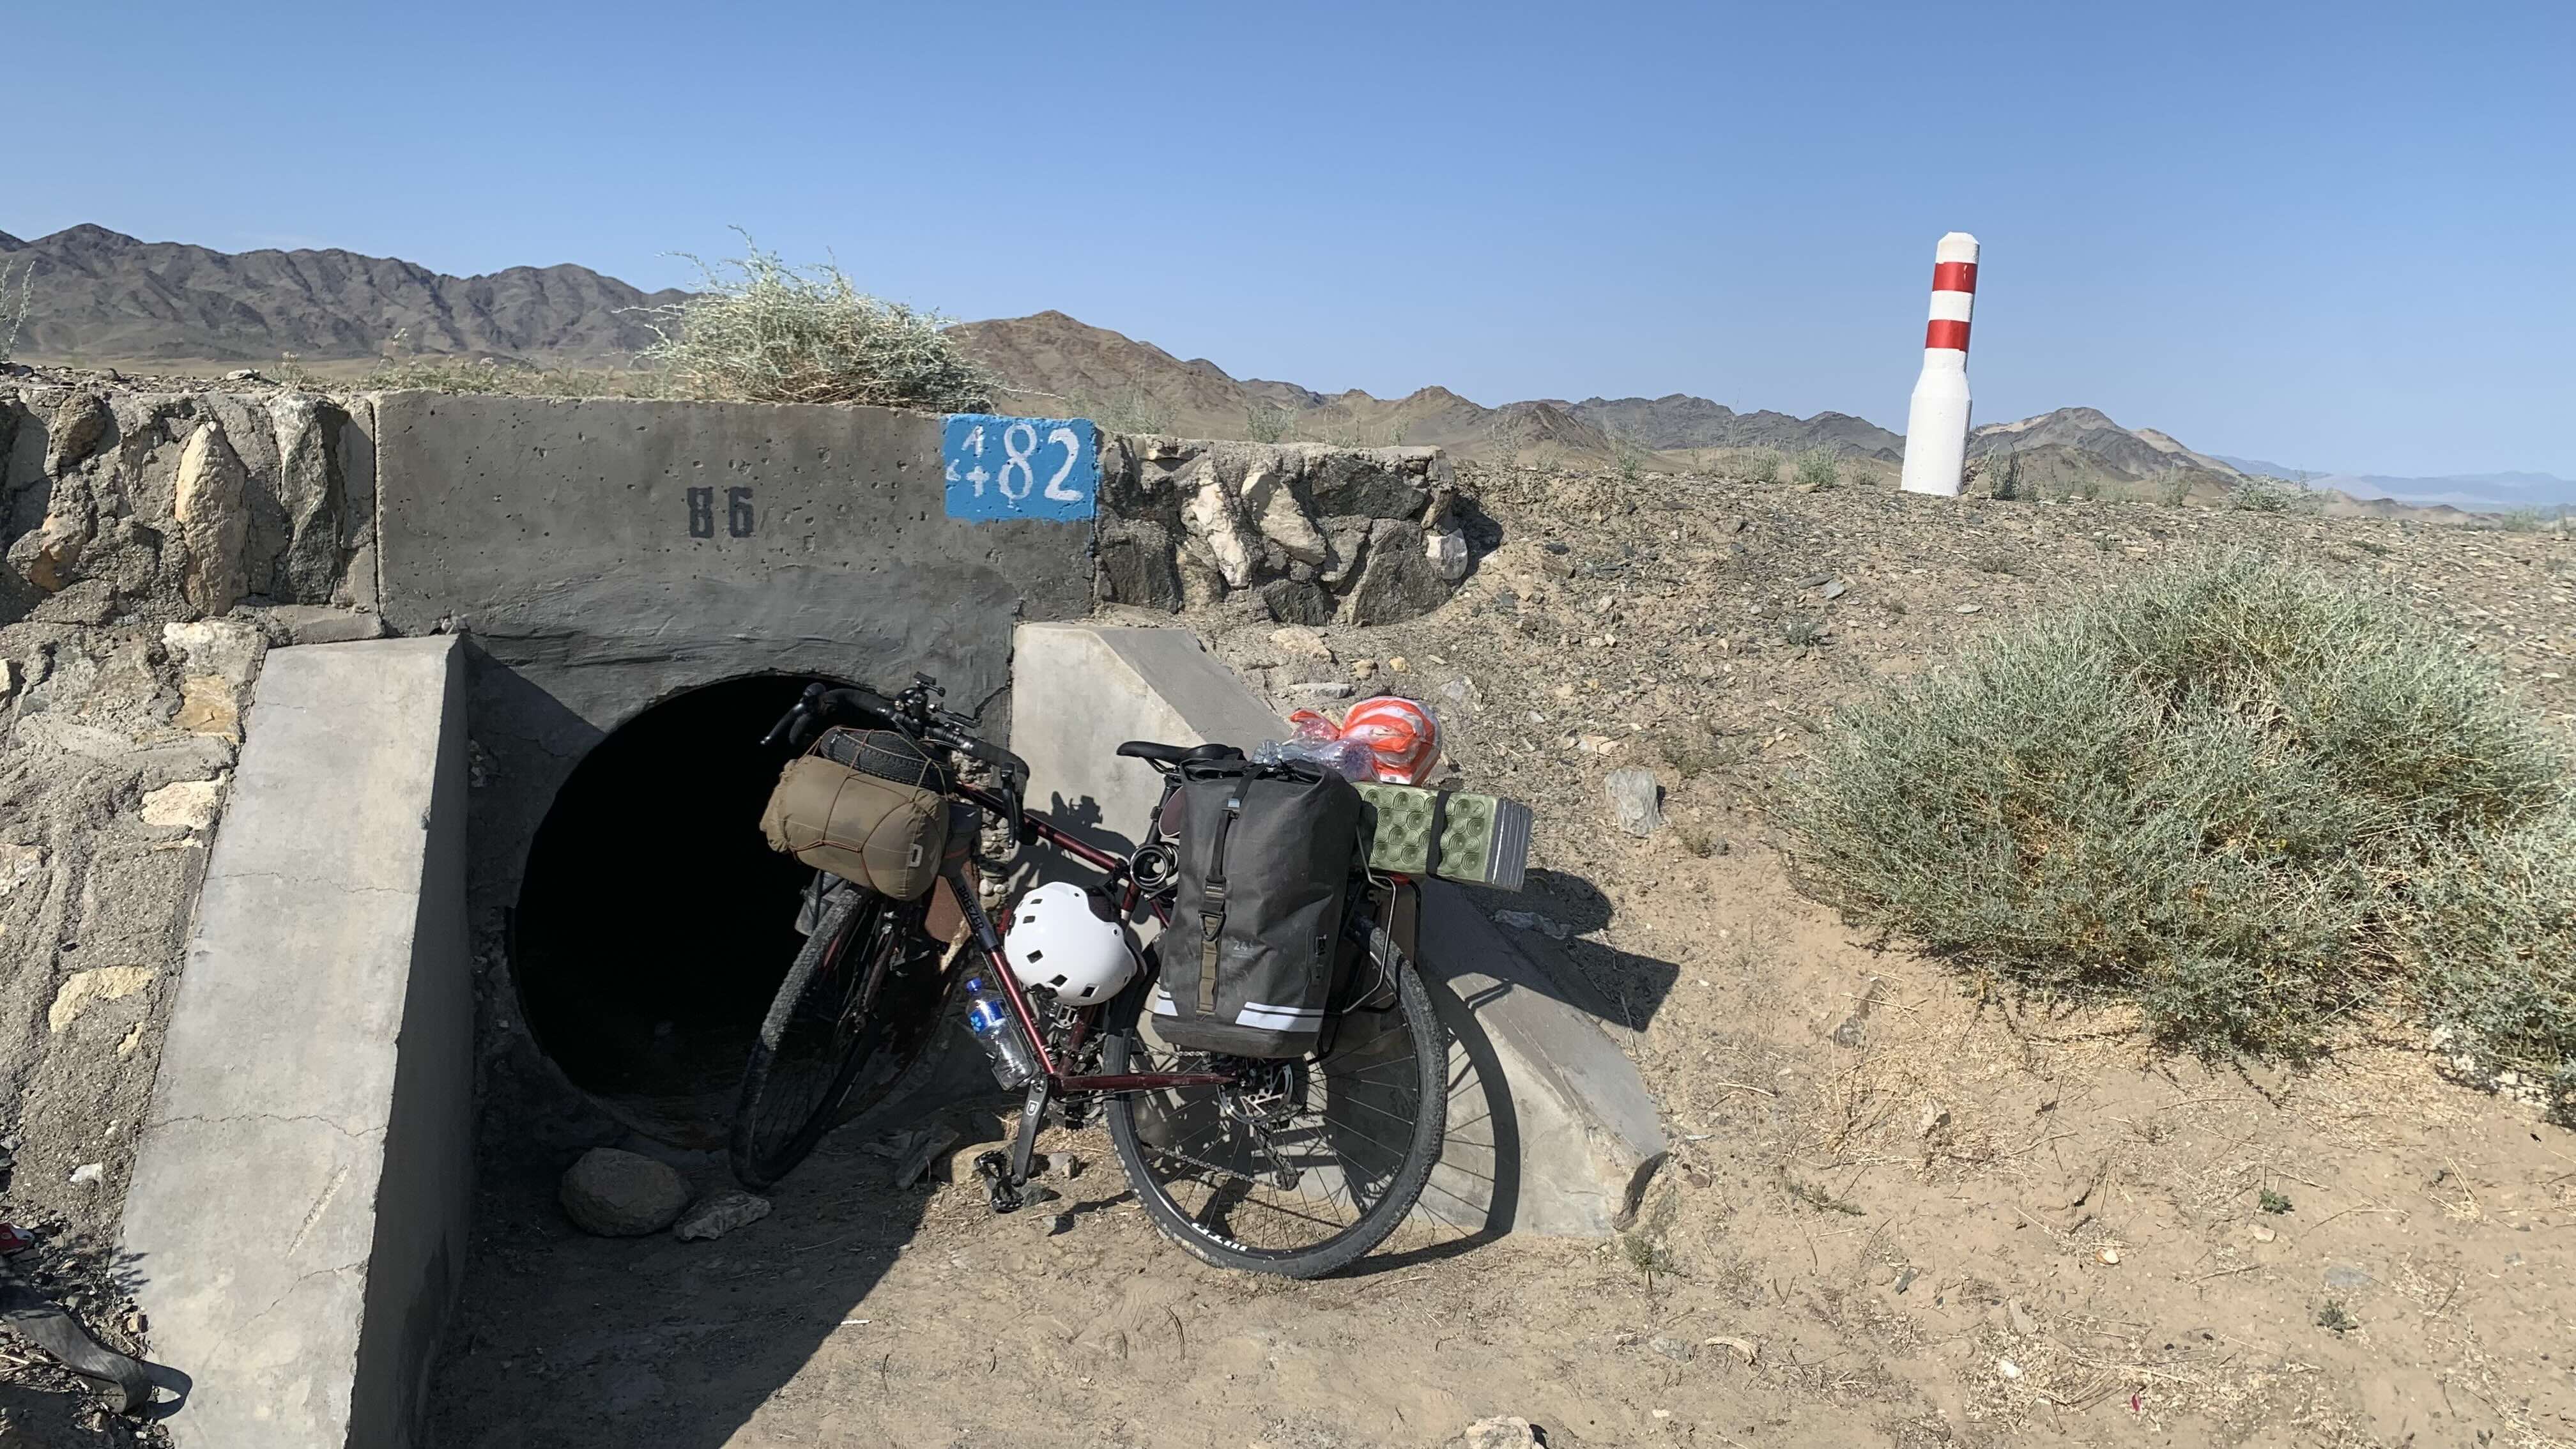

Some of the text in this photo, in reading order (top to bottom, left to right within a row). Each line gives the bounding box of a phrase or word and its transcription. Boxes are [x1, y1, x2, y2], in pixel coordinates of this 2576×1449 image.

[946, 422, 1084, 502] 482
[687, 486, 754, 538] 86
[958, 885, 984, 929] BREEZER
